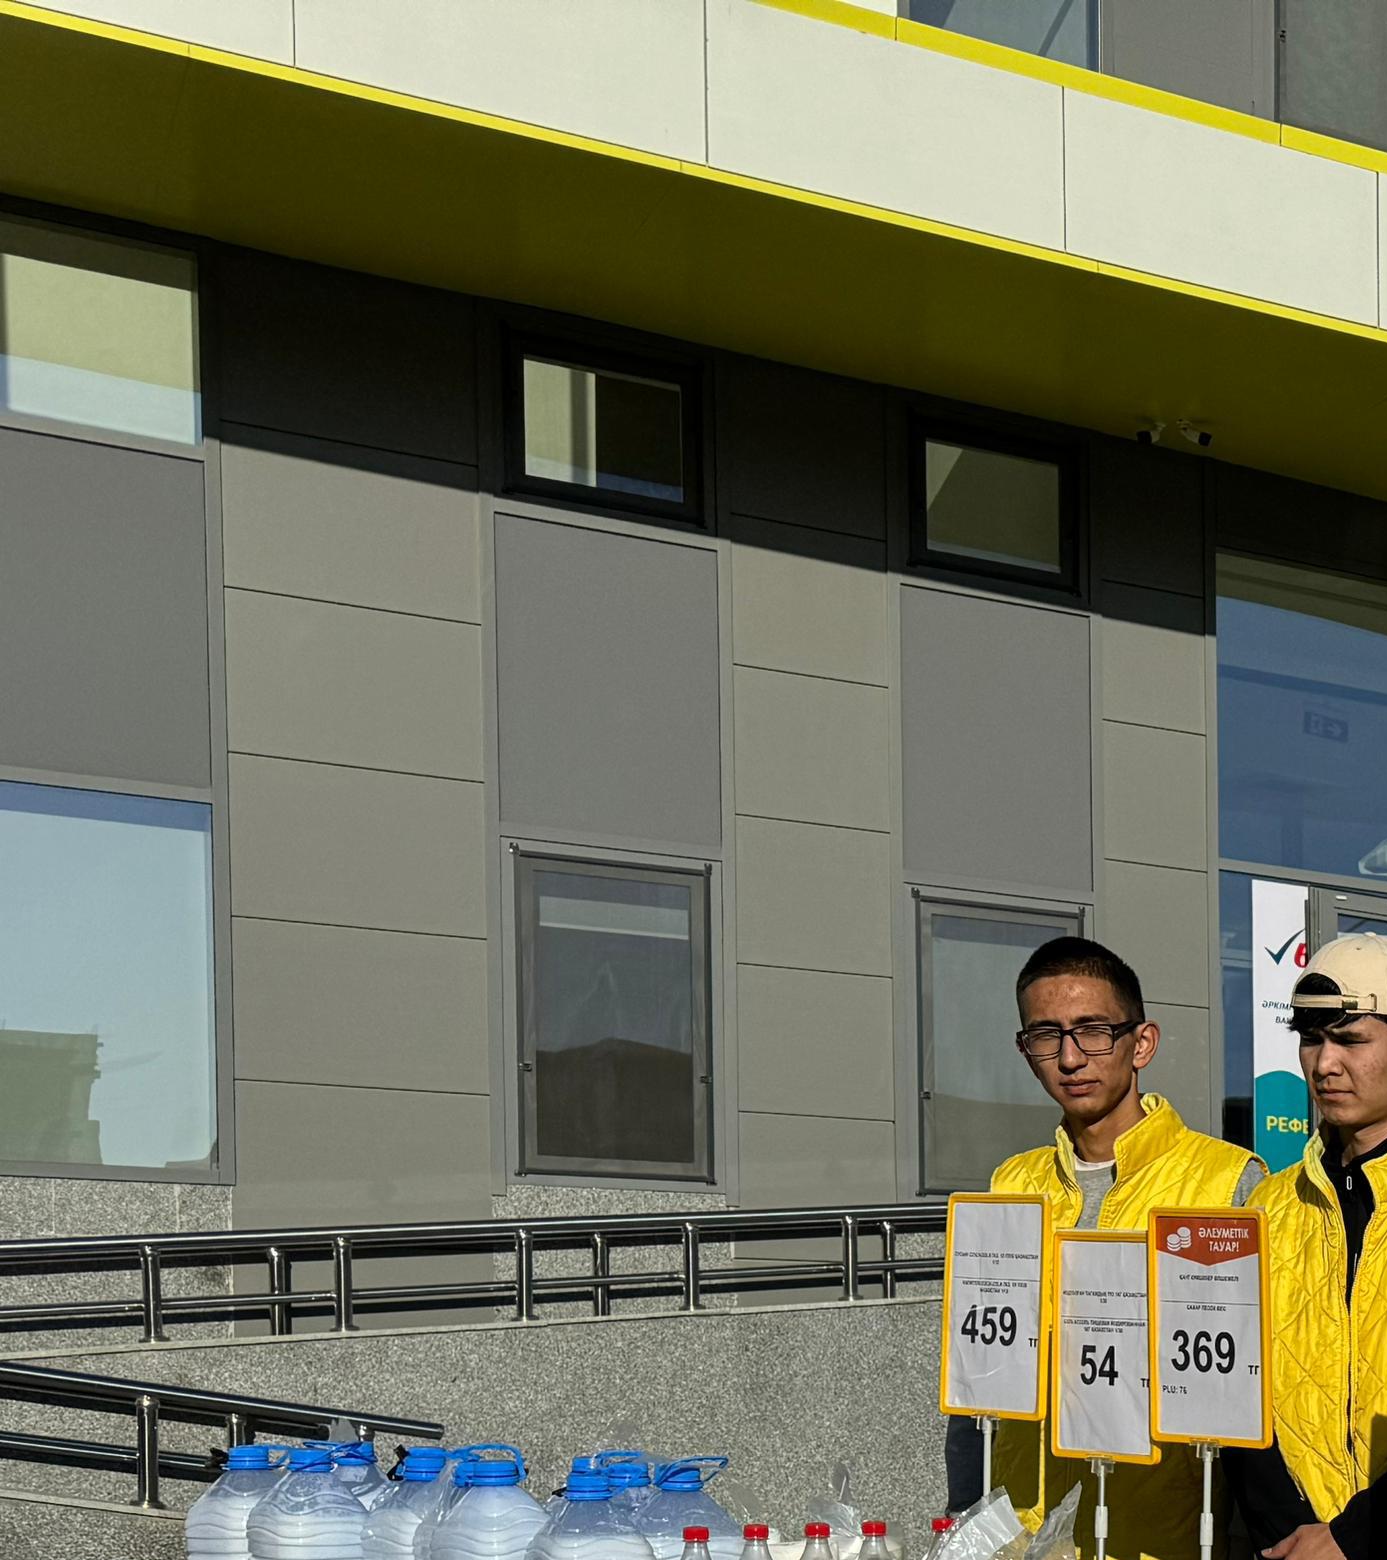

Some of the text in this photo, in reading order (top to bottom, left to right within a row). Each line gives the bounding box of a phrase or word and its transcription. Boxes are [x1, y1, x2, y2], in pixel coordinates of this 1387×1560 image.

[1198, 1227, 1249, 1239] ӘЛЕУМЕТТІК
[1209, 1241, 1239, 1252] ТАУАР!
[961, 1304, 1017, 1347] 459
[1080, 1344, 1119, 1386] 54
[1170, 1329, 1236, 1375] 369
